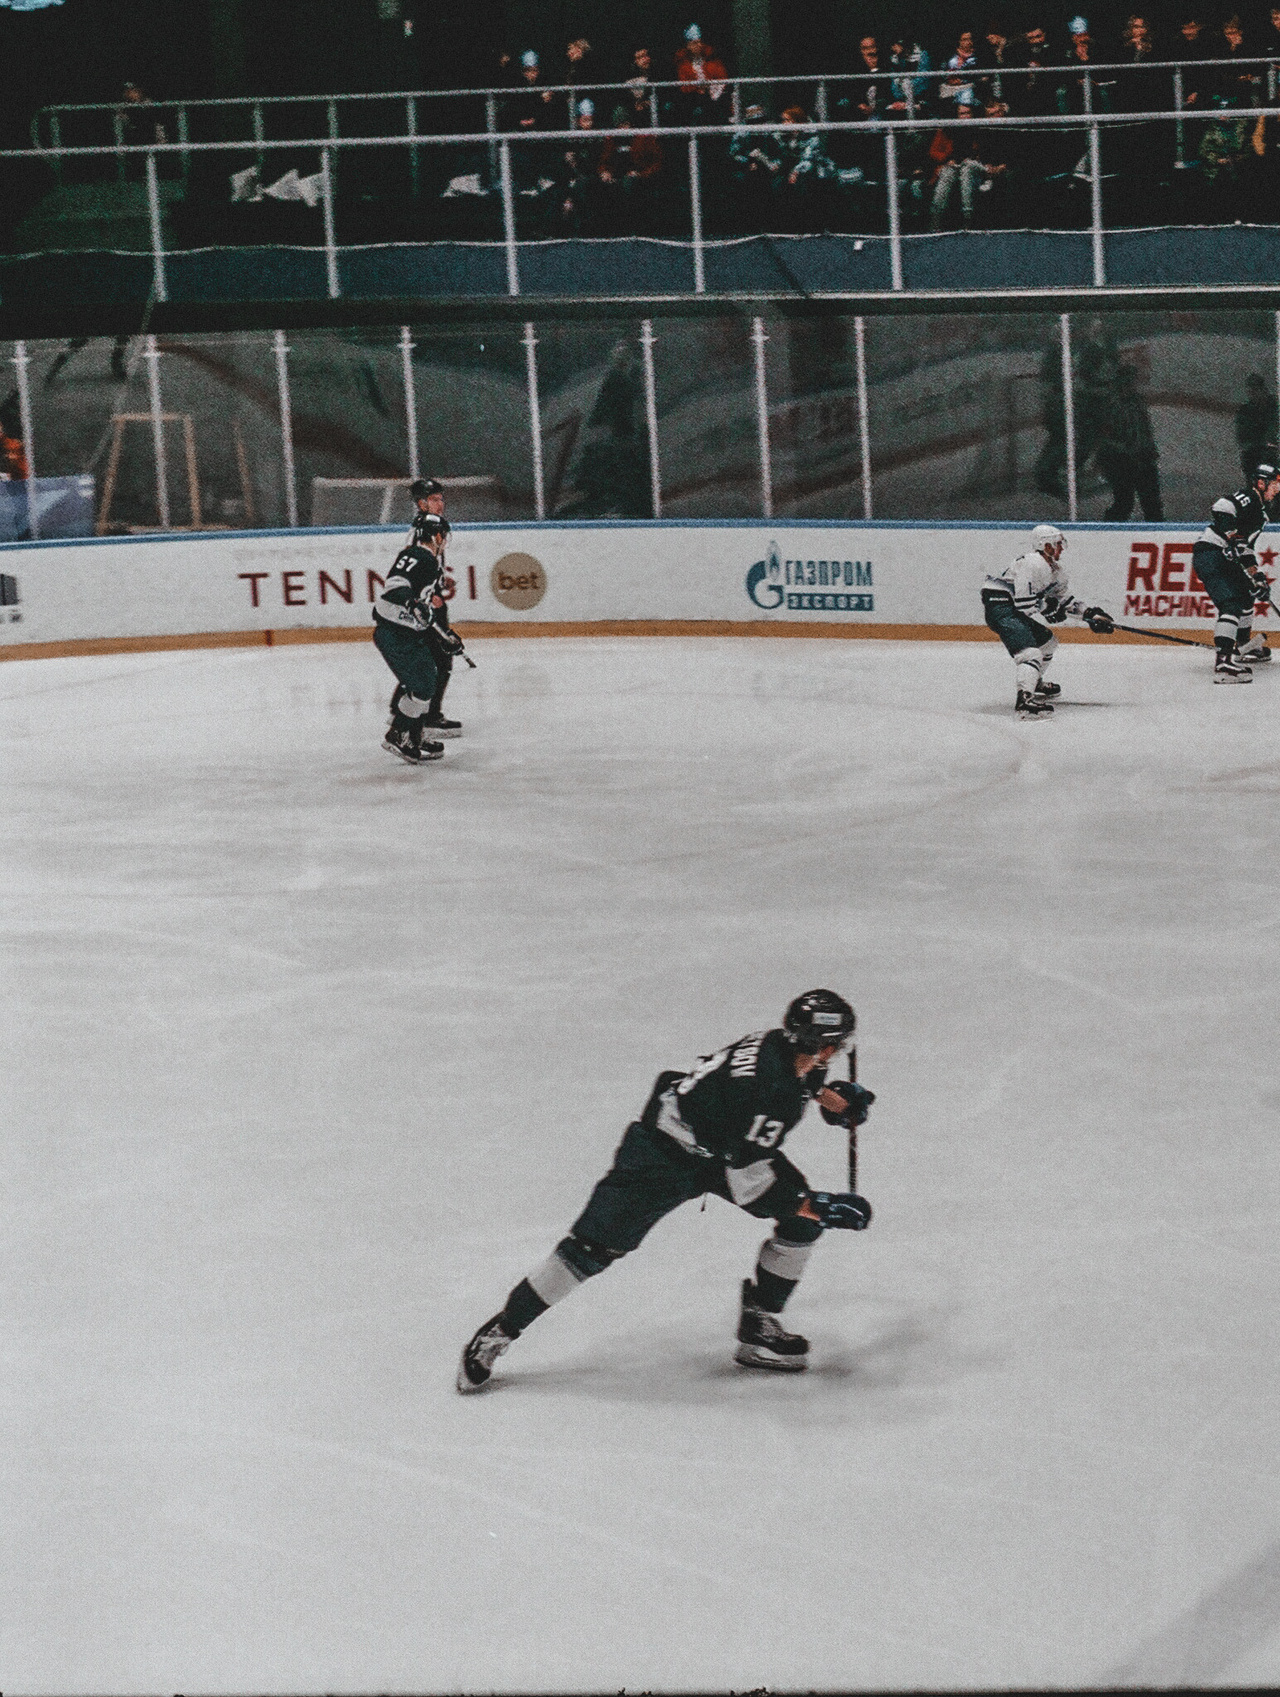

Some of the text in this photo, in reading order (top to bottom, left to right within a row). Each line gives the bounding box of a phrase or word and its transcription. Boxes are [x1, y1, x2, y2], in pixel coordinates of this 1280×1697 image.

[785, 560, 873, 587] ГАЗПРОМ
[1127, 542, 1207, 592] RE
[498, 571, 541, 591] bet
[788, 594, 872, 610] ЭКСПОРТ
[1124, 594, 1217, 618] MACHINE
[744, 1114, 785, 1148] 13
